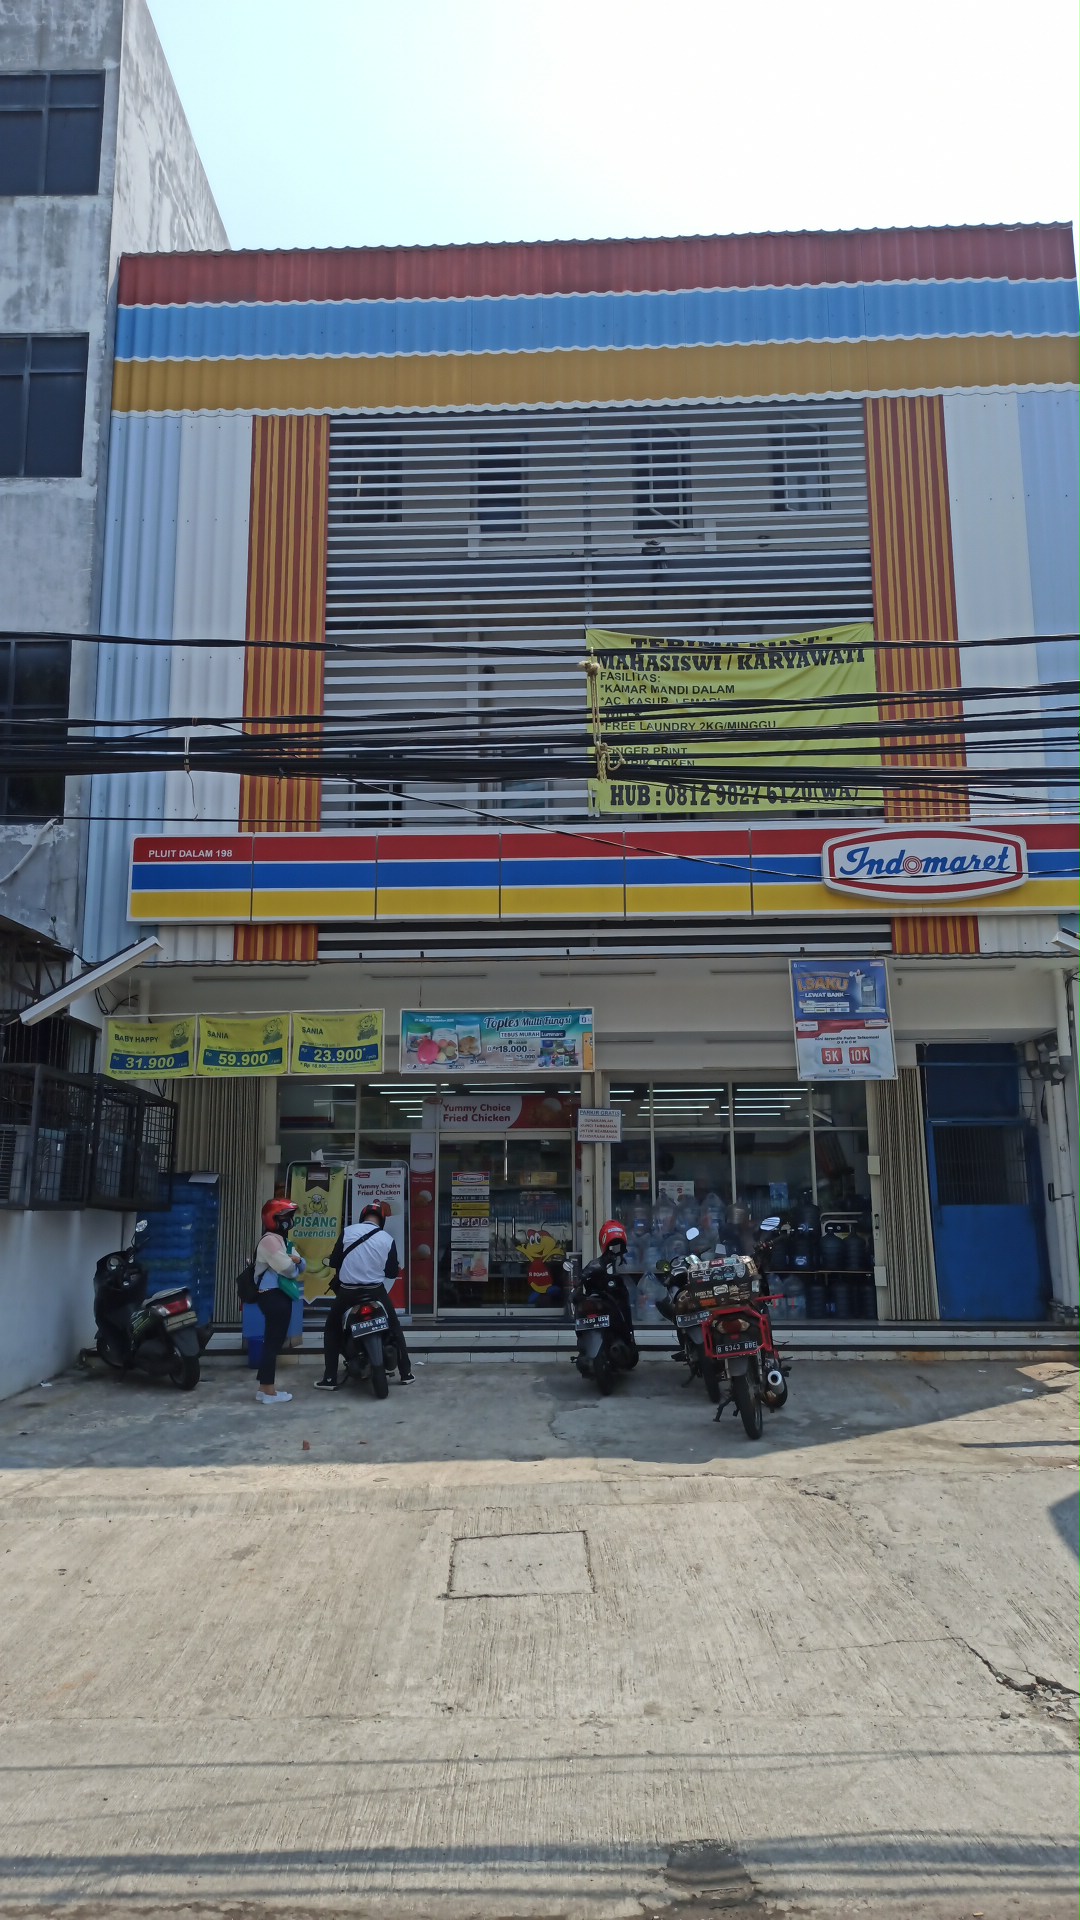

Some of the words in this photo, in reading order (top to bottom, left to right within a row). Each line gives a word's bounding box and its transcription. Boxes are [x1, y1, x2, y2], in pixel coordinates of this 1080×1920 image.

[597, 651, 721, 671] MAHASISWI
[727, 655, 732, 670] /
[738, 649, 864, 670] KARYAWATI
[600, 672, 660, 683] FASILITAS:
[650, 685, 688, 694] MANDI
[692, 685, 735, 694] DALAM
[640, 722, 695, 731] LAUNDRY
[700, 721, 775, 731] 2KG/MINGGU
[610, 785, 650, 806] HUB
[665, 783, 710, 806] 0812
[716, 784, 760, 806] 9827
[148, 849, 177, 858] PLUIT
[179, 849, 213, 858] DALAM
[216, 849, 232, 857] 198
[840, 846, 1011, 875] Indomaret
[485, 1016, 519, 1031] Toples
[521, 1016, 542, 1026] Multi
[544, 1015, 572, 1027] Fungsi
[207, 1030, 229, 1039] SANIA
[302, 1026, 323, 1035] SANIA
[114, 1033, 134, 1043] BABY
[500, 1045, 527, 1053] 18.000
[125, 1056, 175, 1069] 31.900
[443, 1104, 477, 1113] Yummy
[480, 1103, 511, 1112] Choice
[443, 1113, 468, 1122] Fried
[471, 1113, 511, 1122] Chicken
[294, 1216, 338, 1228] PISANG
[293, 1229, 336, 1238] Cavendish
